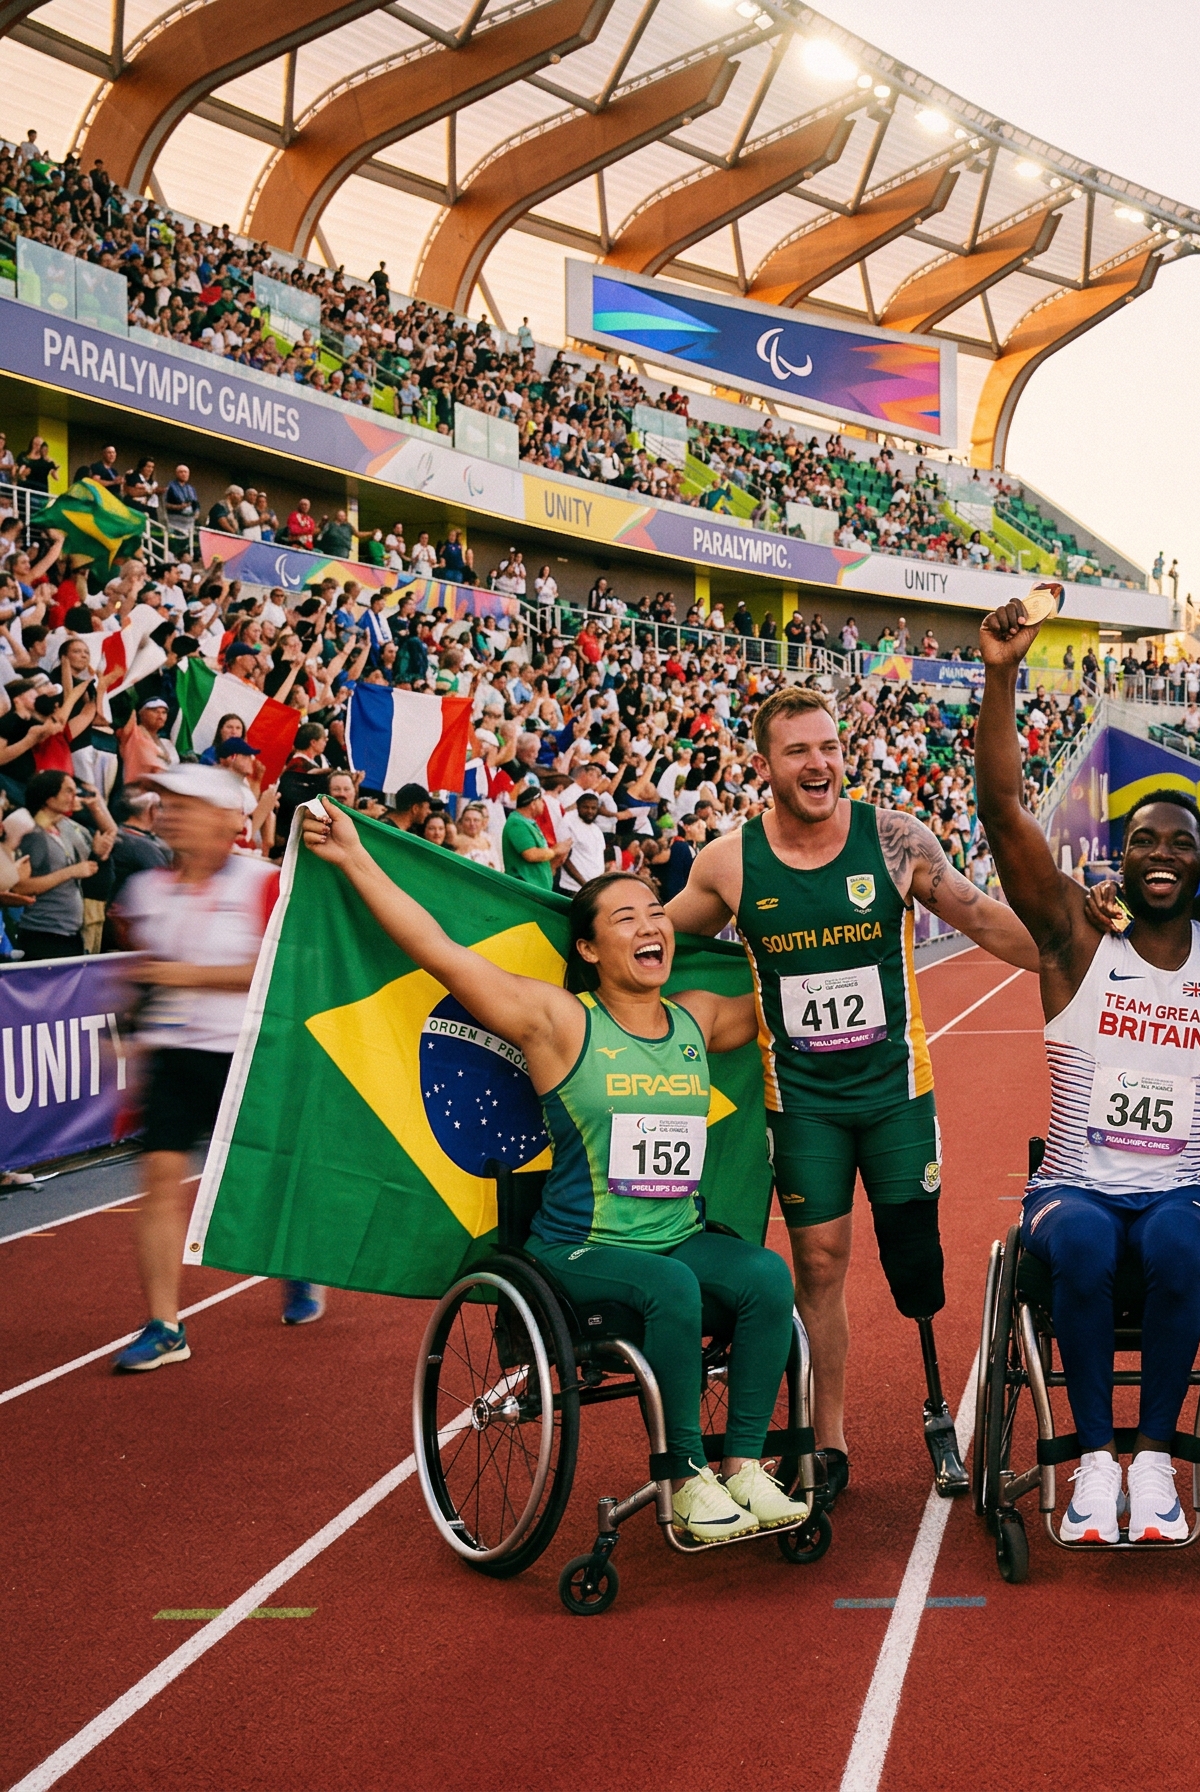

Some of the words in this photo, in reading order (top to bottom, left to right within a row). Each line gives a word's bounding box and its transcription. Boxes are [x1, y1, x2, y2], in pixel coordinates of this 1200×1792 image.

[43, 327, 213, 415] PARALYMPIC
[219, 386, 300, 442] GAMES
[544, 490, 593, 527] UNITY
[904, 568, 949, 594] UNITY
[761, 931, 818, 954] SOUTH
[821, 921, 883, 947] AFRICA
[801, 994, 867, 1032] 412
[1104, 992, 1152, 1017] TEAM
[483, 1036, 493, 1048] E
[606, 1073, 708, 1097] BRASIL
[1106, 1092, 1174, 1133] 345
[632, 1139, 691, 1176] 152
